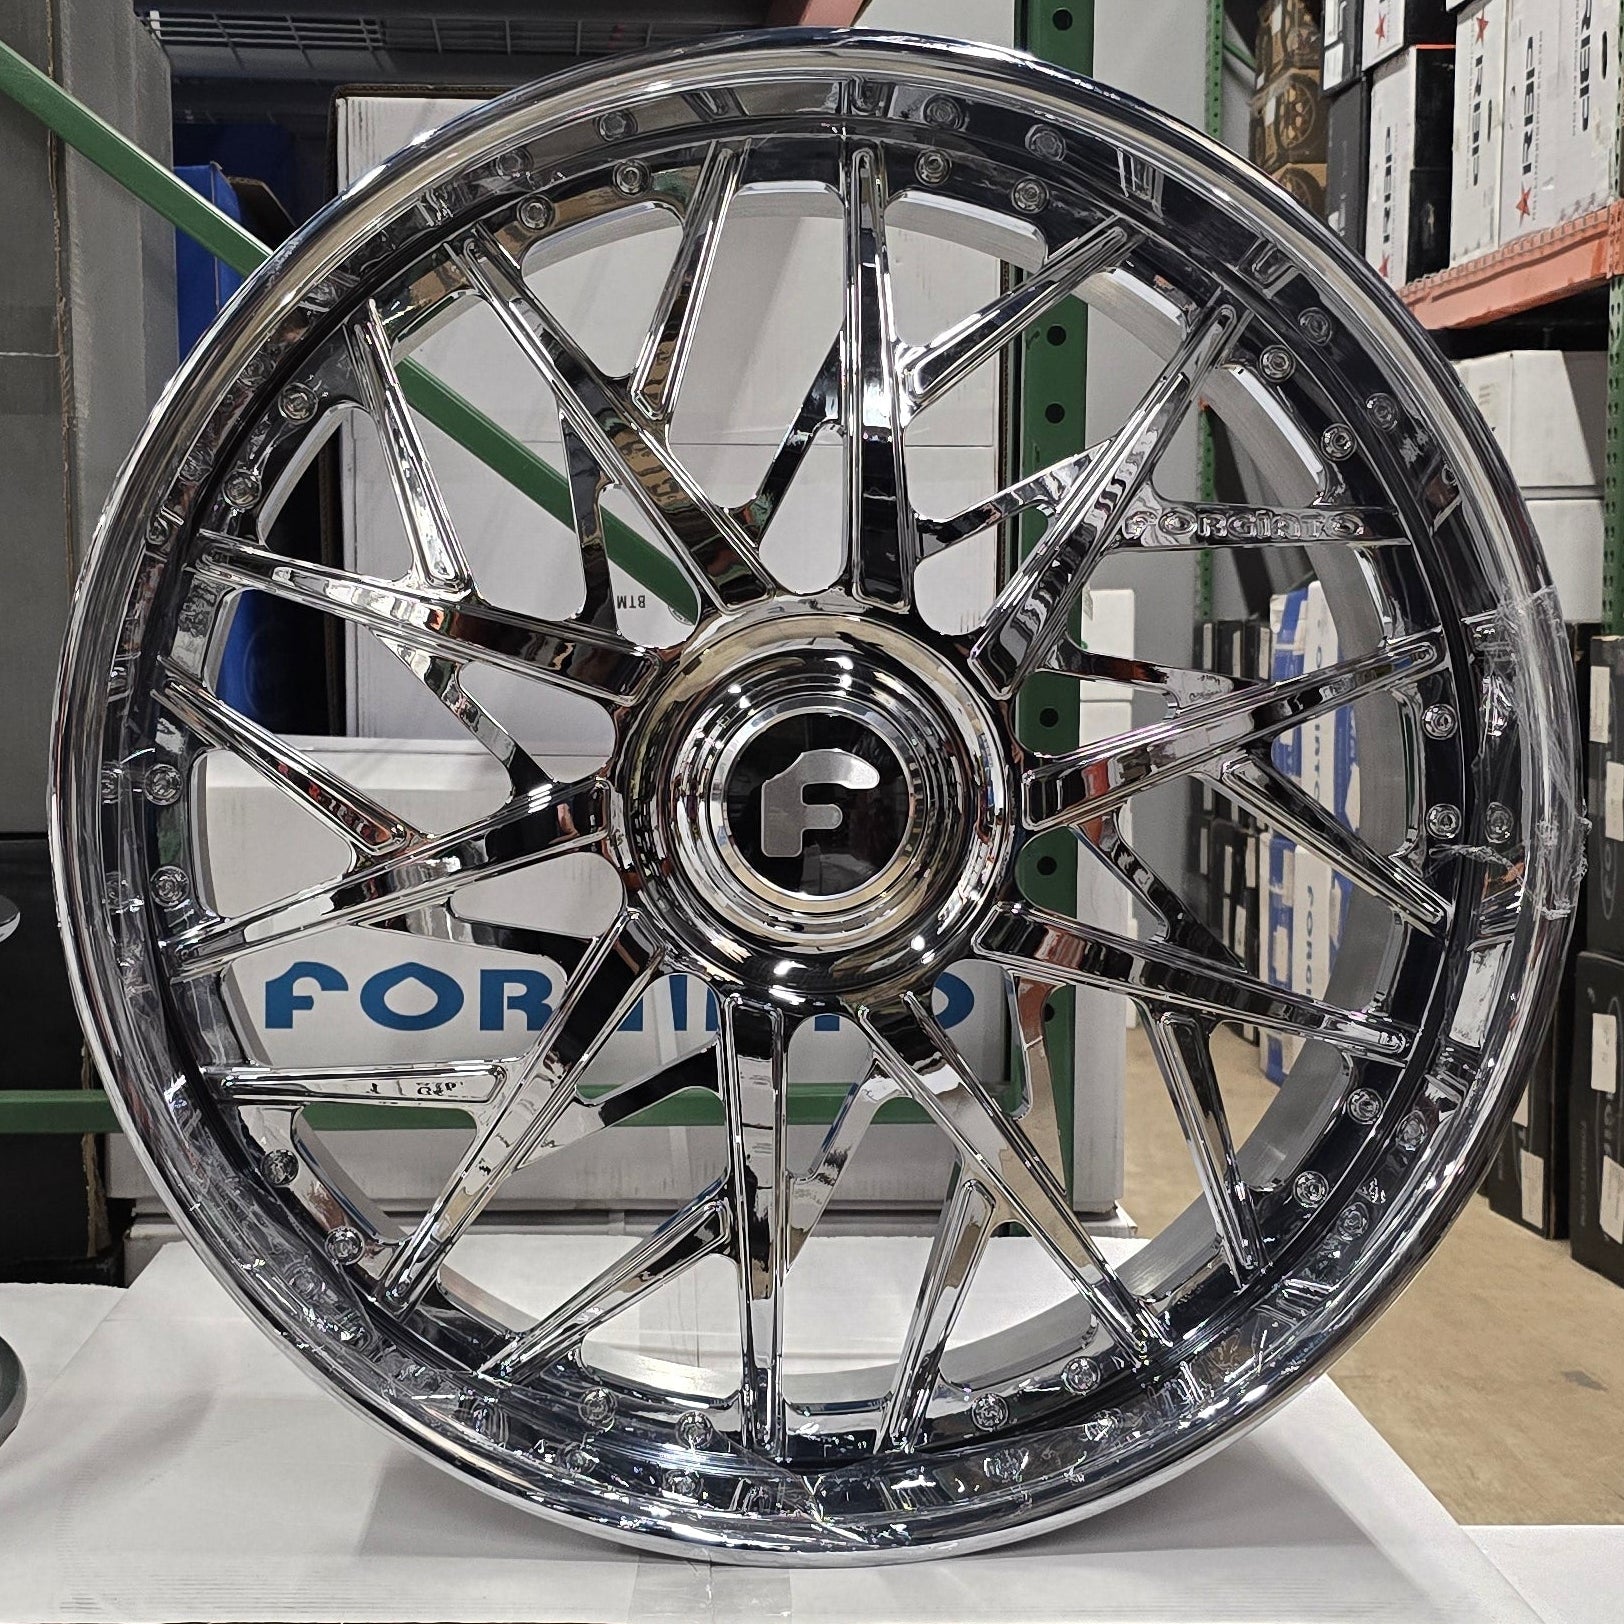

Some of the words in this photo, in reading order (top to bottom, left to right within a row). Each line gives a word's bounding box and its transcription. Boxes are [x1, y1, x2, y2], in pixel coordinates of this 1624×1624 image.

[1472, 54, 1484, 186] RBP
[1522, 36, 1535, 176] RBP
[1122, 508, 1366, 540] FORGIATO
[617, 595, 646, 609] BTM
